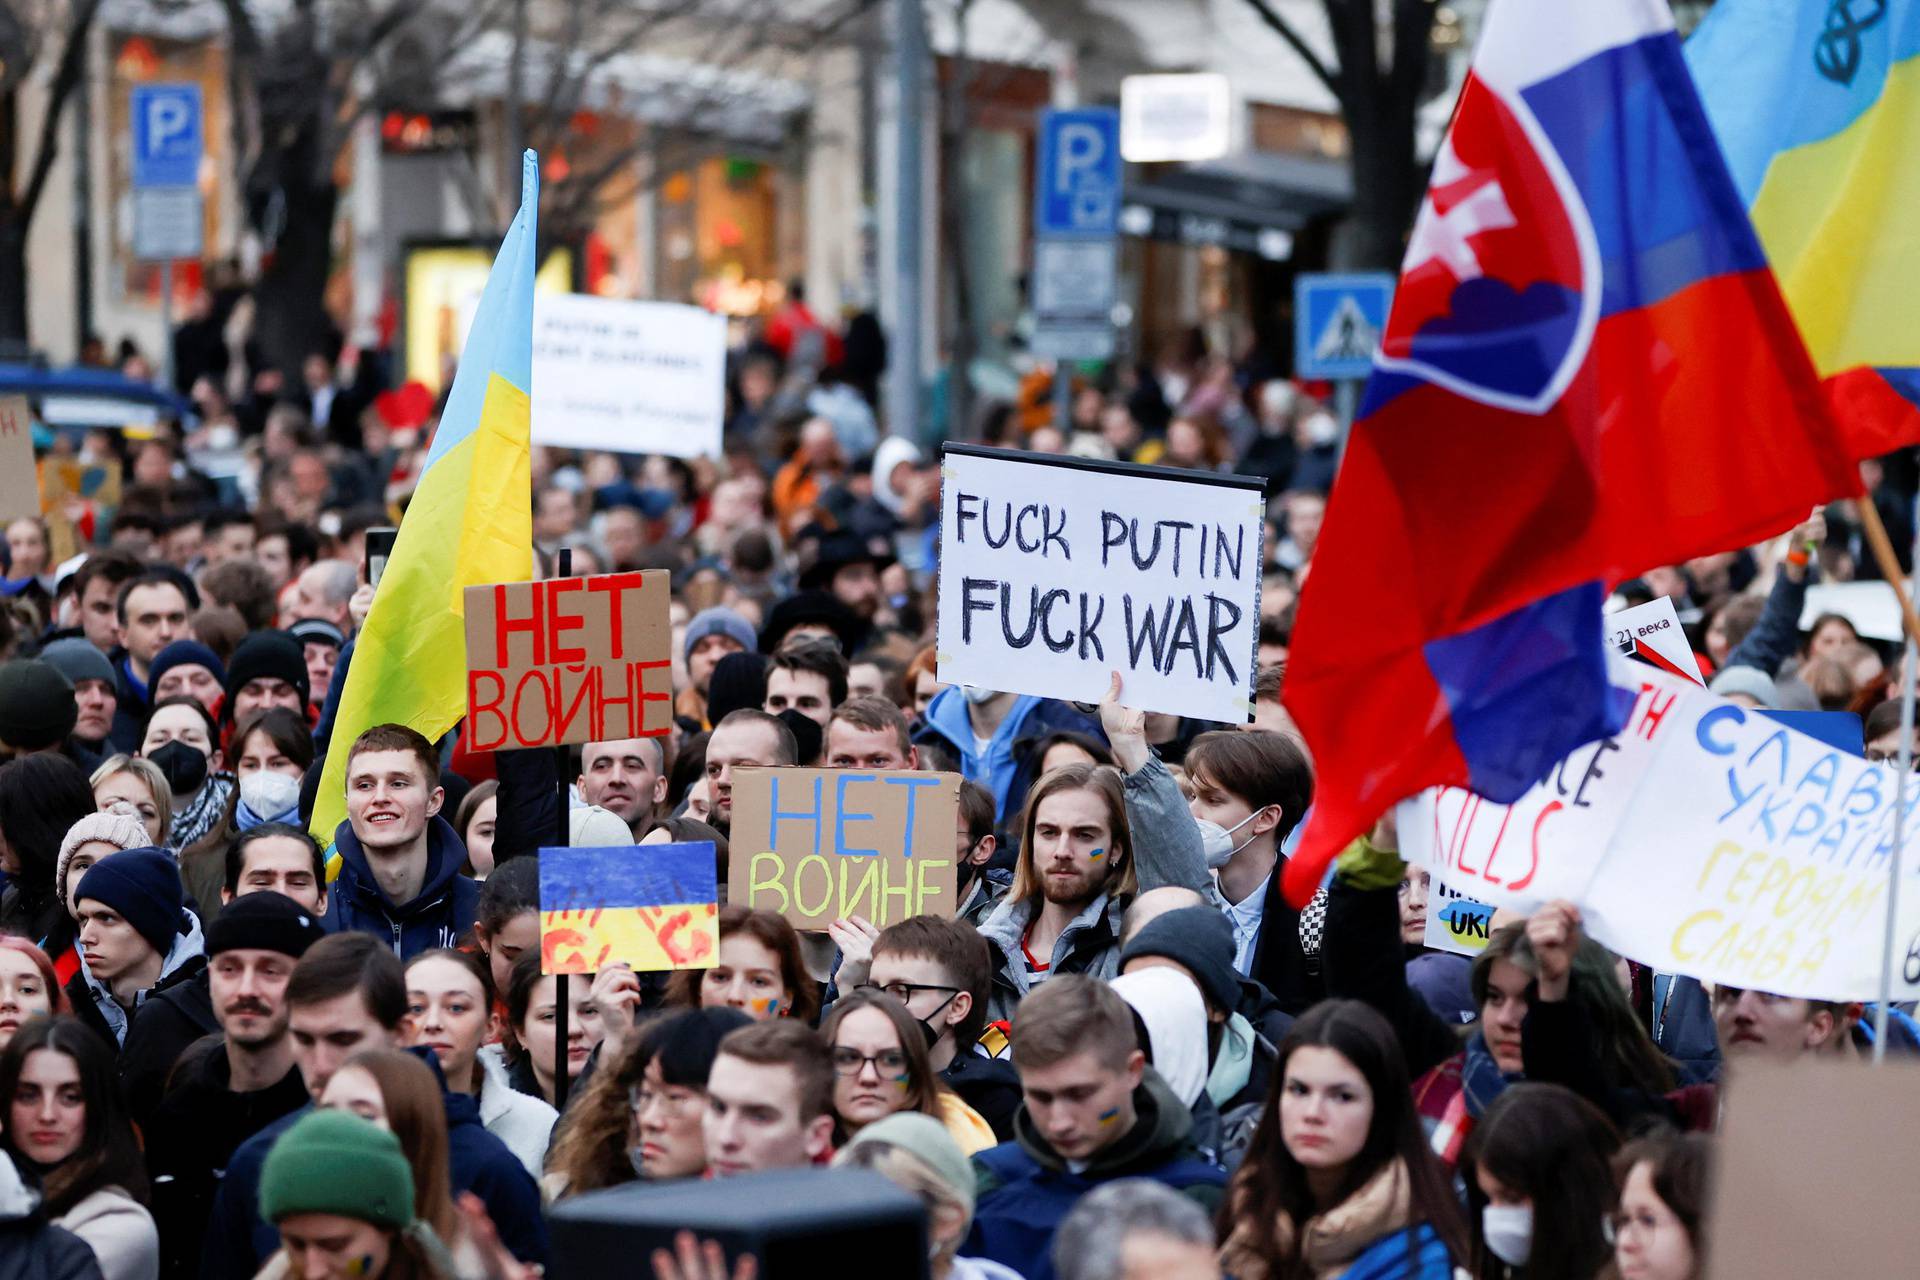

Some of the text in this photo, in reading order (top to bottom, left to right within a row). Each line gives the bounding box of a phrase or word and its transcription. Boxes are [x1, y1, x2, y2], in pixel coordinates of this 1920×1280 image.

[957, 490, 1244, 580] FUCK PUTIN
[495, 574, 642, 668] НЕТ
[962, 576, 1242, 686] FUCK WAR
[1638, 618, 1671, 638] века
[469, 660, 672, 750] ВОЙНЕ
[769, 774, 941, 857] НЕТ
[750, 853, 950, 926] ВОЙНЕ
[1696, 840, 1888, 936] ГЕРОЯМ
[1670, 908, 1832, 985] СЛАВА
